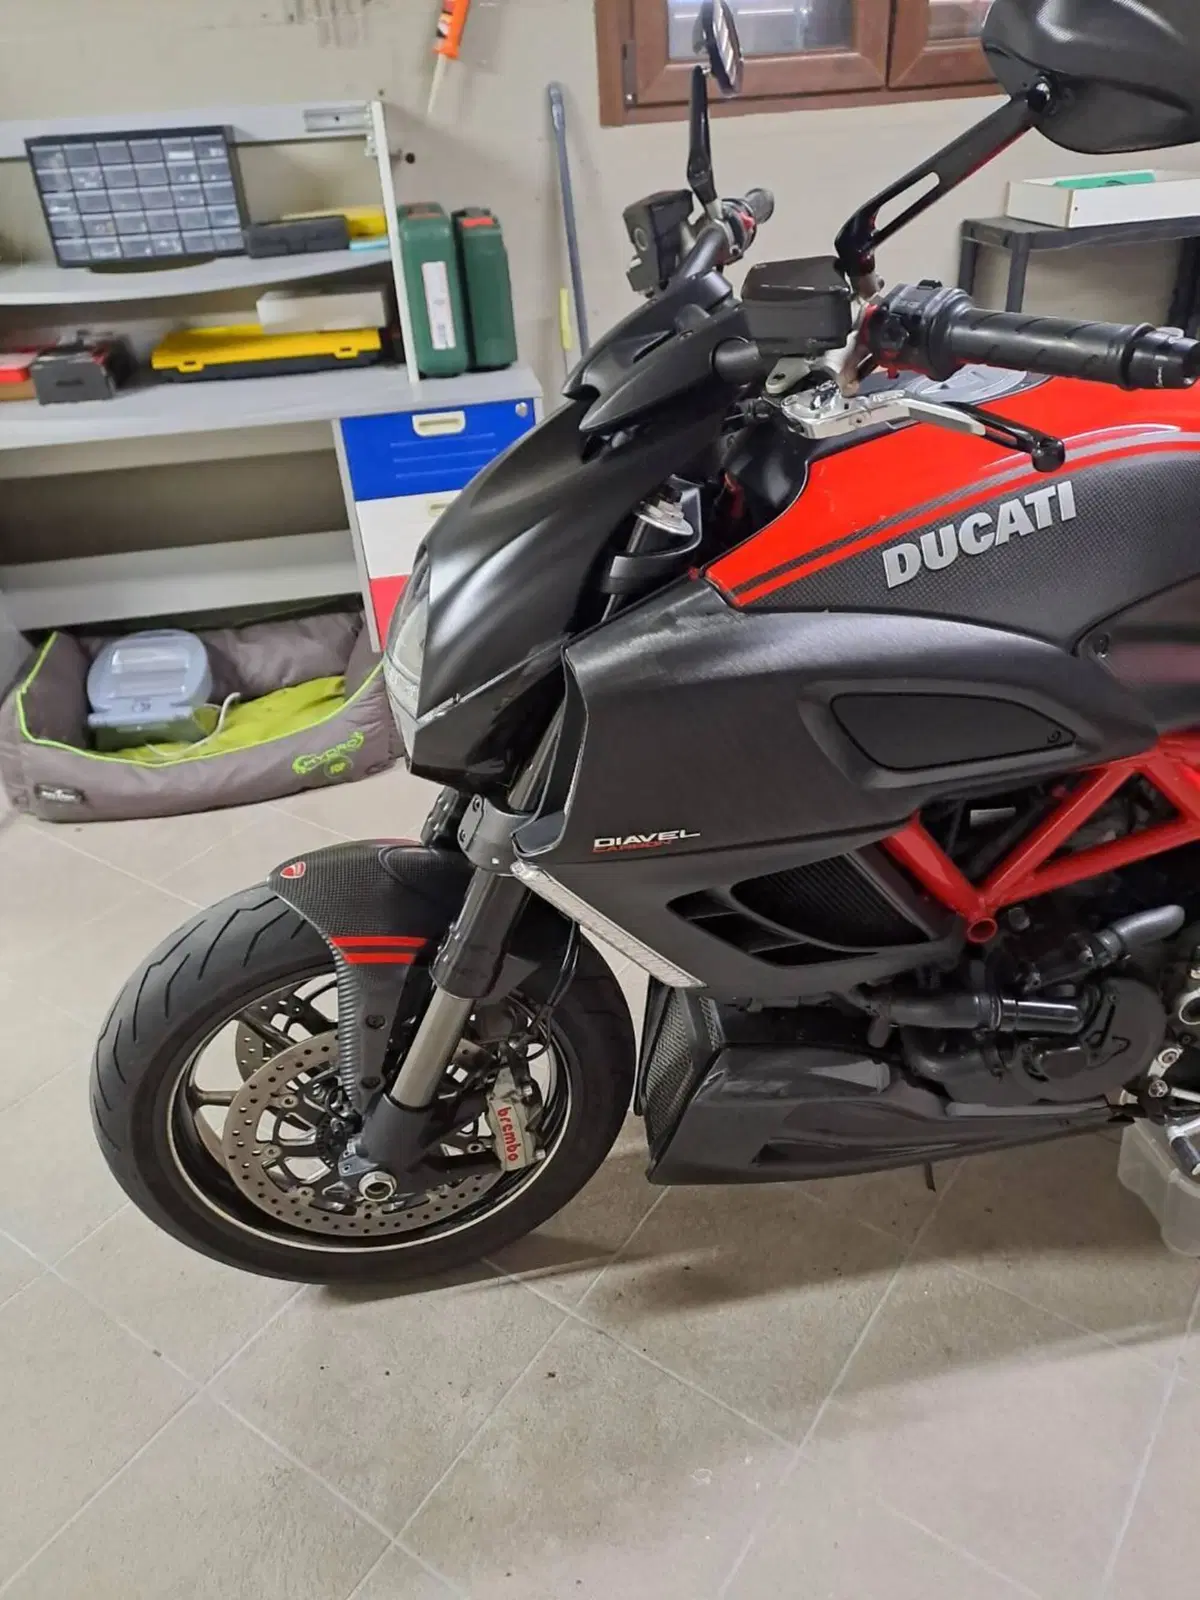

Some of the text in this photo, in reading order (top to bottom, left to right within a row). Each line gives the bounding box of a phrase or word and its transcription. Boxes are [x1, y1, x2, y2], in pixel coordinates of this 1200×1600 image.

[882, 480, 1077, 589] DUCATI
[593, 829, 701, 849] DIAVEL
[497, 1106, 522, 1162] brembo
